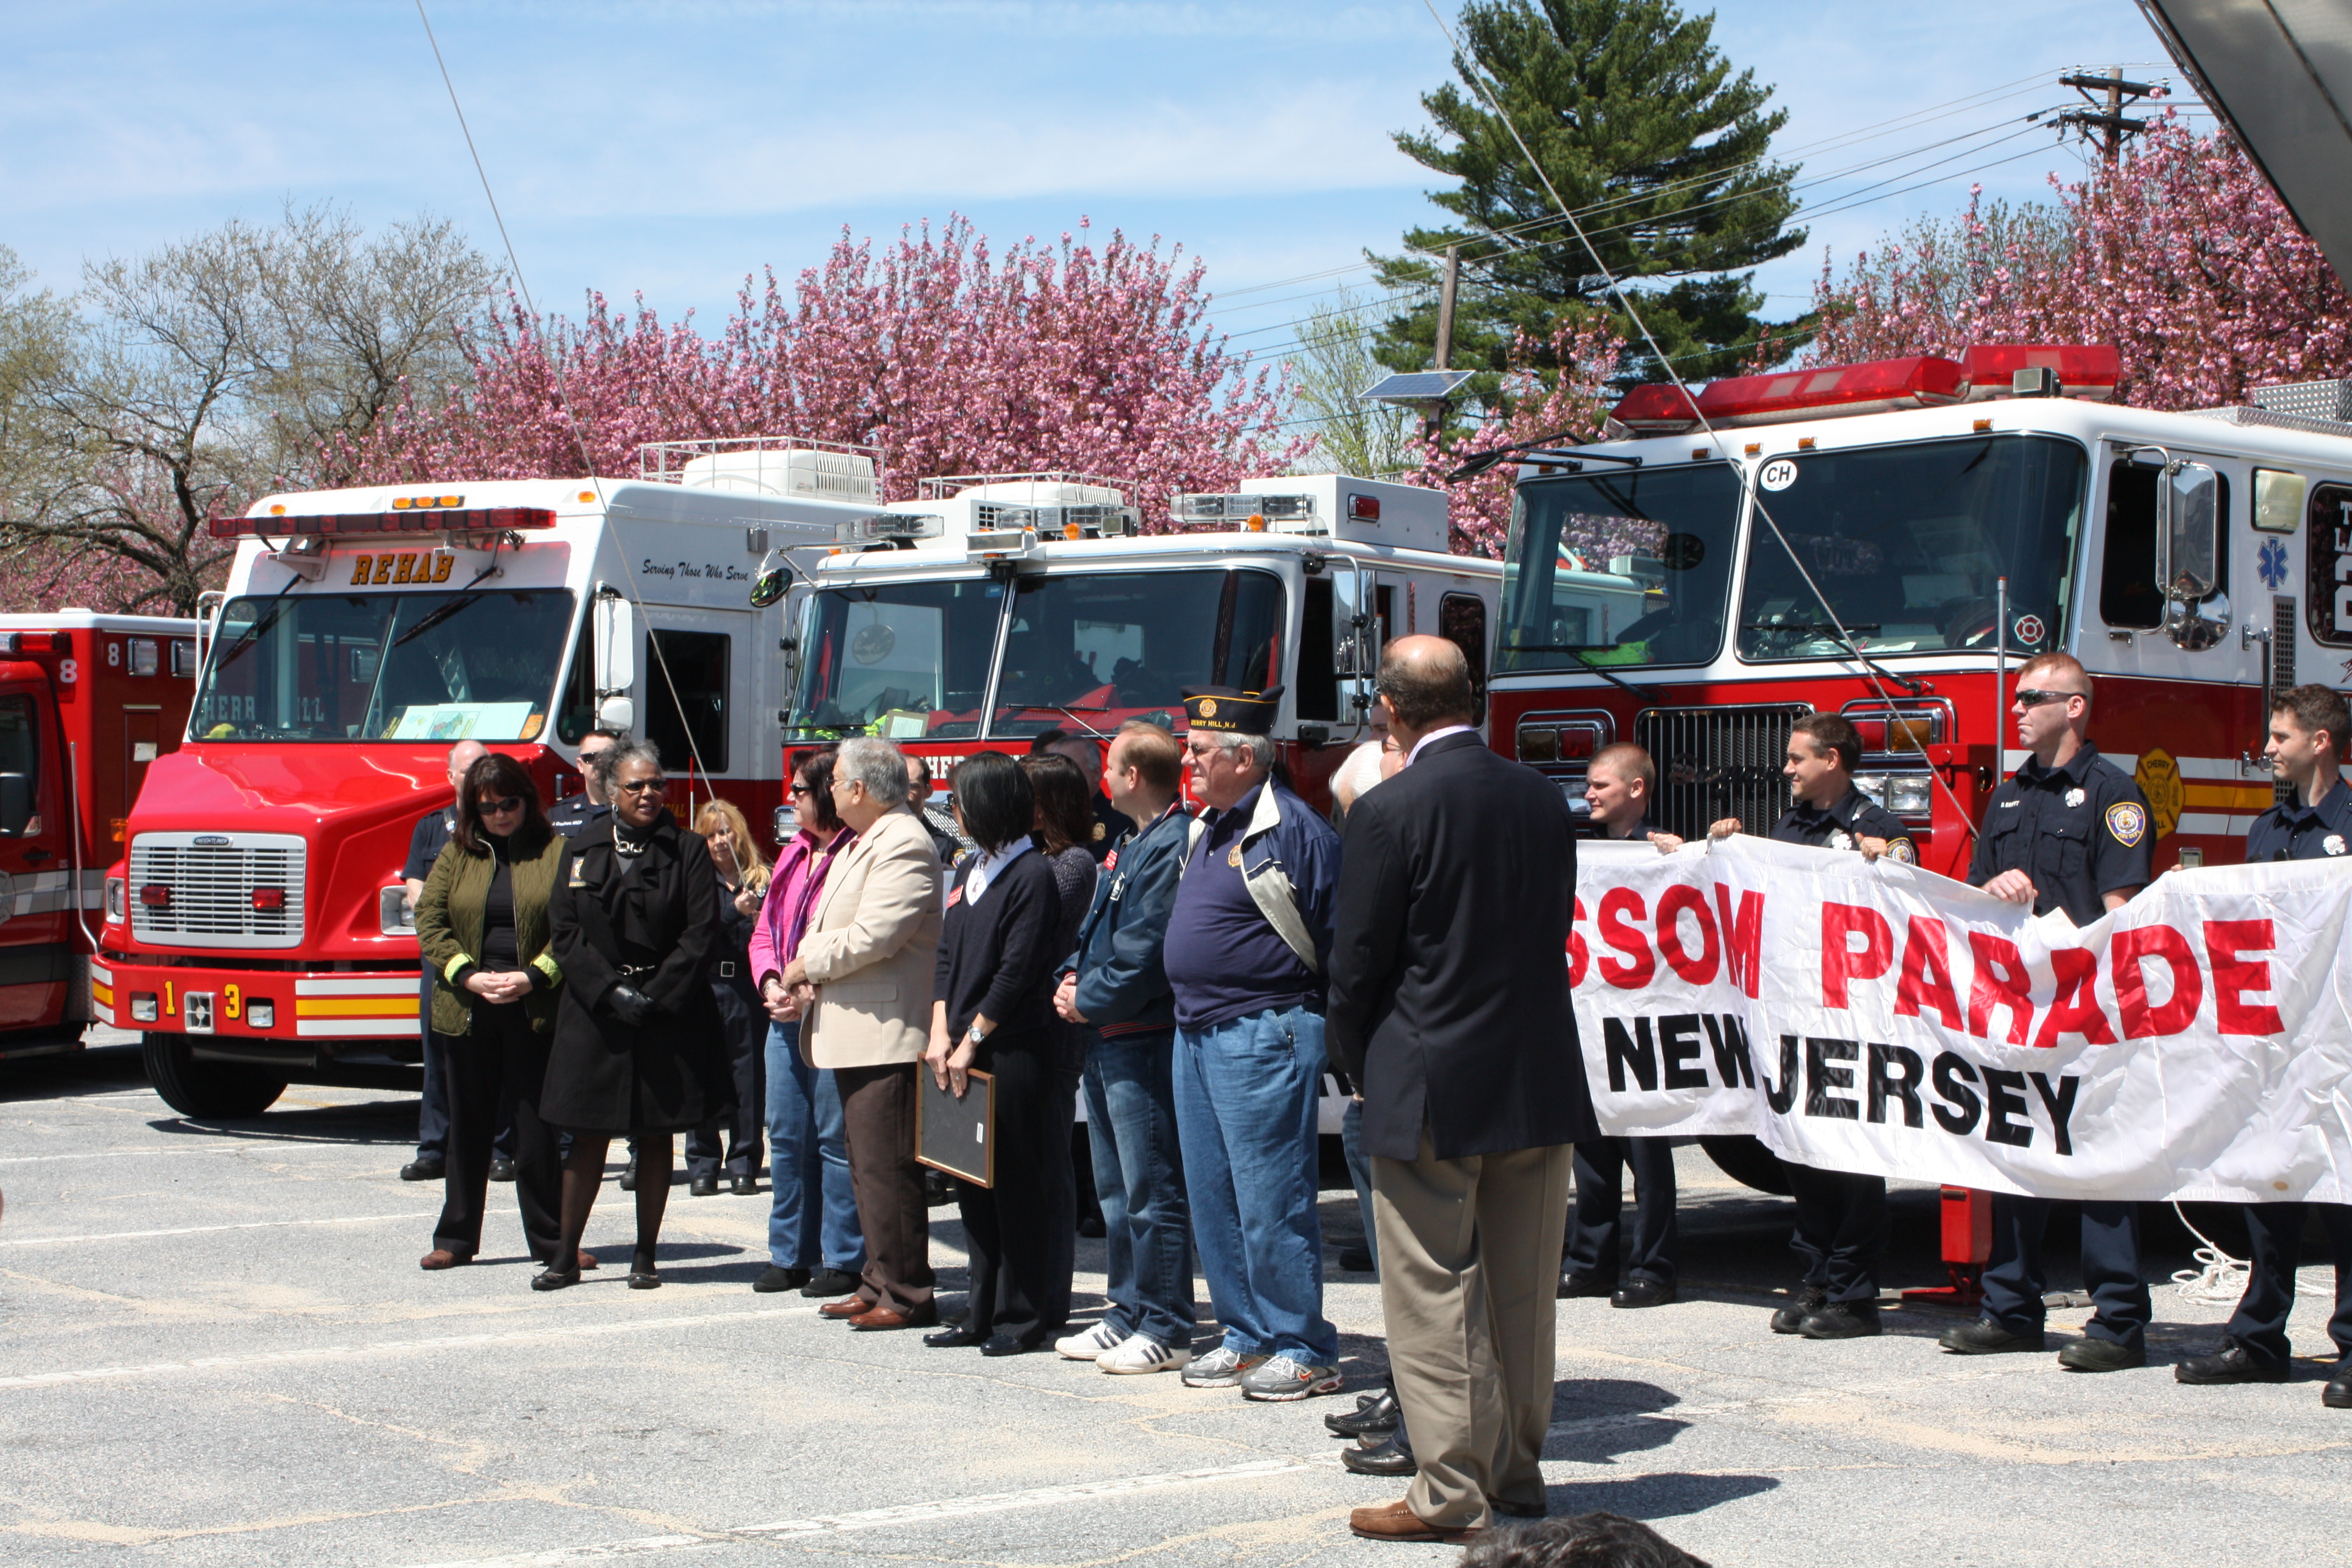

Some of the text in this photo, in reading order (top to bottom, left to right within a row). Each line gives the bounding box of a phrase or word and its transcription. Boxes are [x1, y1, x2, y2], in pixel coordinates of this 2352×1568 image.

[1766, 465, 1791, 483] CH
[350, 553, 455, 585] REHAB
[642, 559, 749, 581] Serving Those Who Serve
[107, 642, 119, 667] 8
[59, 658, 77, 683] 8
[2146, 759, 2170, 770] CHERRY
[1821, 901, 2285, 1048] PARADE
[165, 981, 241, 1020] 1 3
[1603, 1013, 2080, 1156] NEW JERSEY
